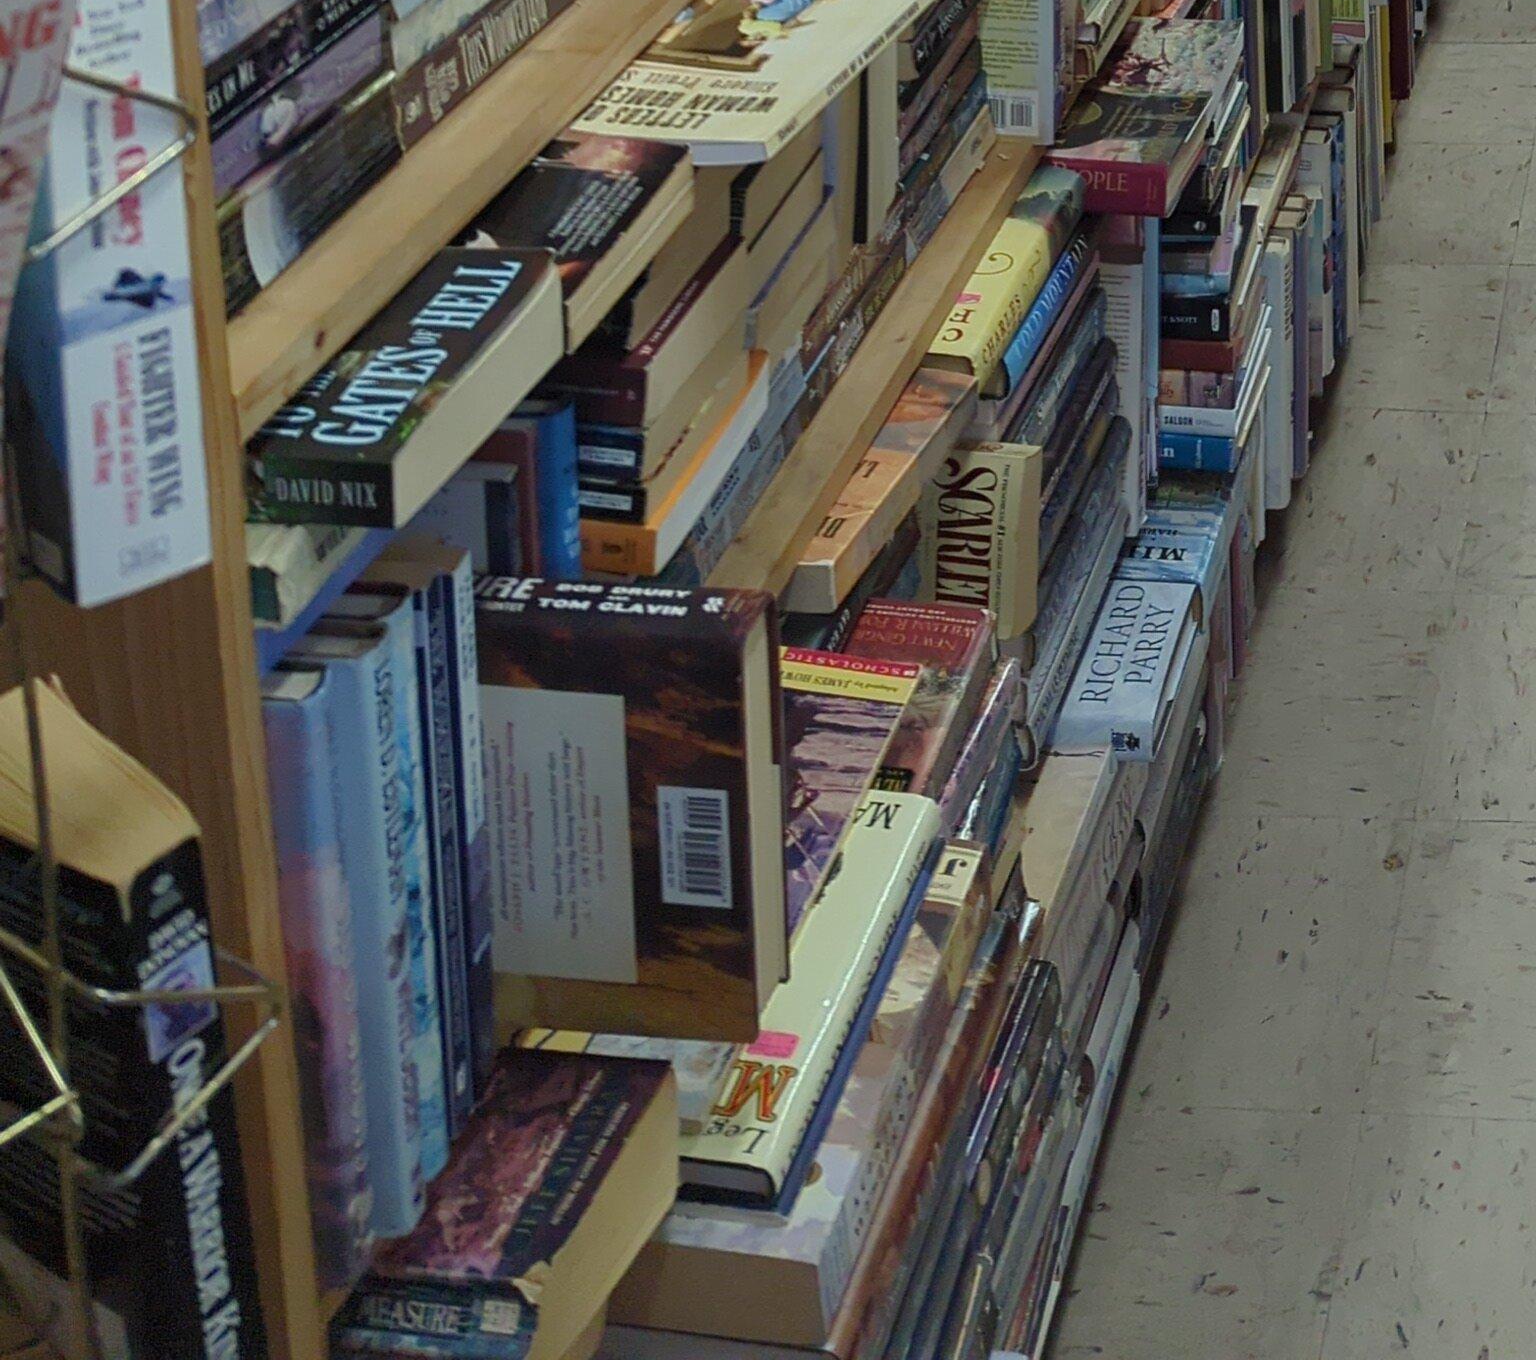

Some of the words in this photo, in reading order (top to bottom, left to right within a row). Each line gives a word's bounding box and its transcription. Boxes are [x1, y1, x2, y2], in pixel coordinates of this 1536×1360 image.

[410, 259, 523, 330] HELL
[409, 329, 442, 347] OF
[980, 296, 1019, 366] CHARLES
[138, 327, 177, 446] FIGHTER
[312, 345, 448, 447] GATES
[275, 478, 334, 506] DAVID
[340, 484, 377, 510] NIX
[537, 597, 593, 611] TOM
[599, 601, 688, 617] CLAVIN
[555, 583, 604, 594] BOB
[610, 586, 693, 599] DRURY
[786, 651, 903, 678] SCHOLASTIC
[1080, 586, 1145, 704] RICHARD
[1124, 605, 1176, 684] PARRY
